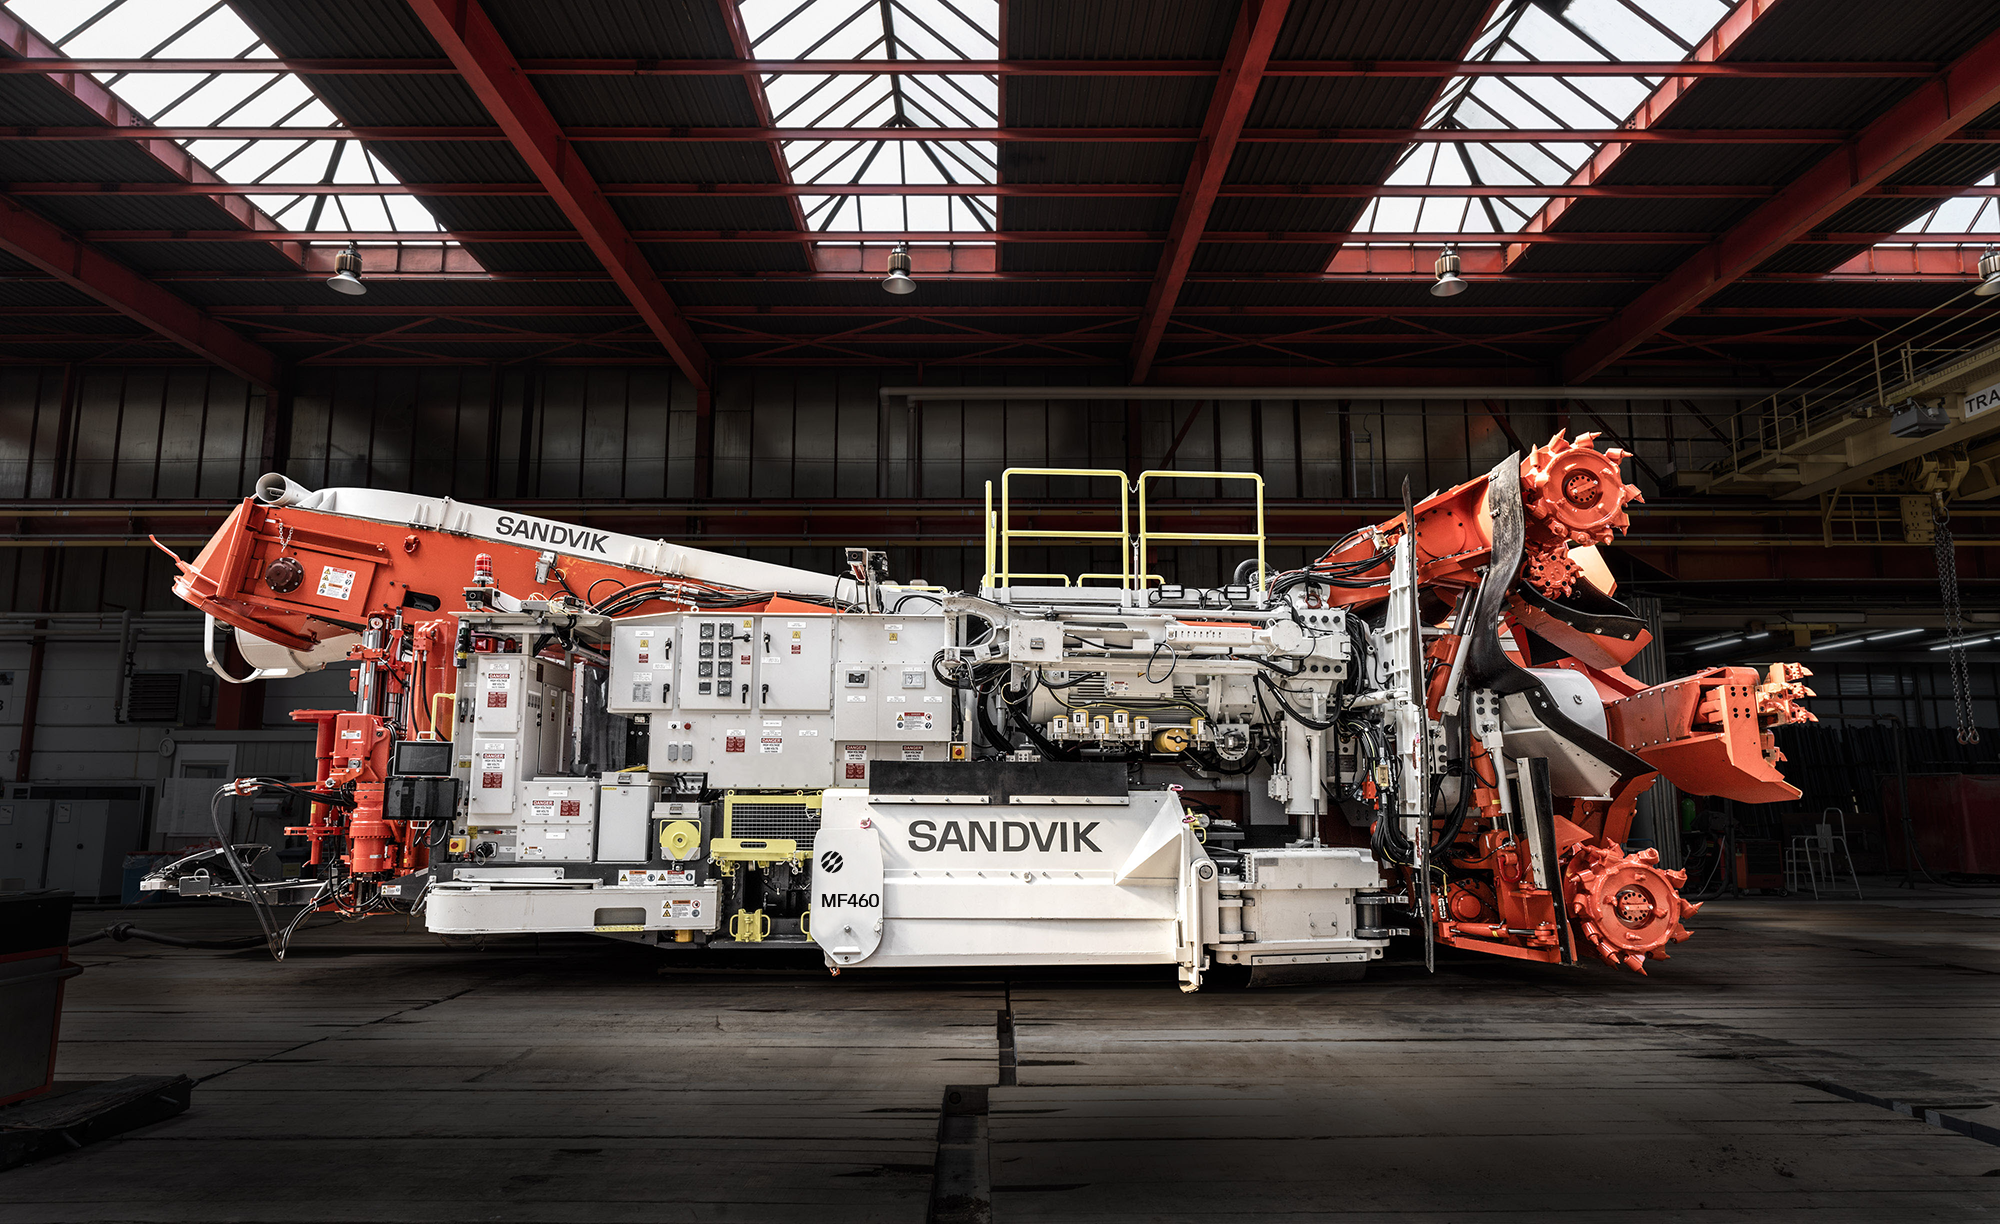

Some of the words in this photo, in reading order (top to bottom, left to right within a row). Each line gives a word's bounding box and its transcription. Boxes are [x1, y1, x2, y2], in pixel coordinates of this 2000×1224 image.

[1965, 389, 2000, 412] TRA
[496, 516, 609, 554] SANDVIK
[908, 820, 1103, 853] SANDVIK
[822, 894, 880, 908] MF460
